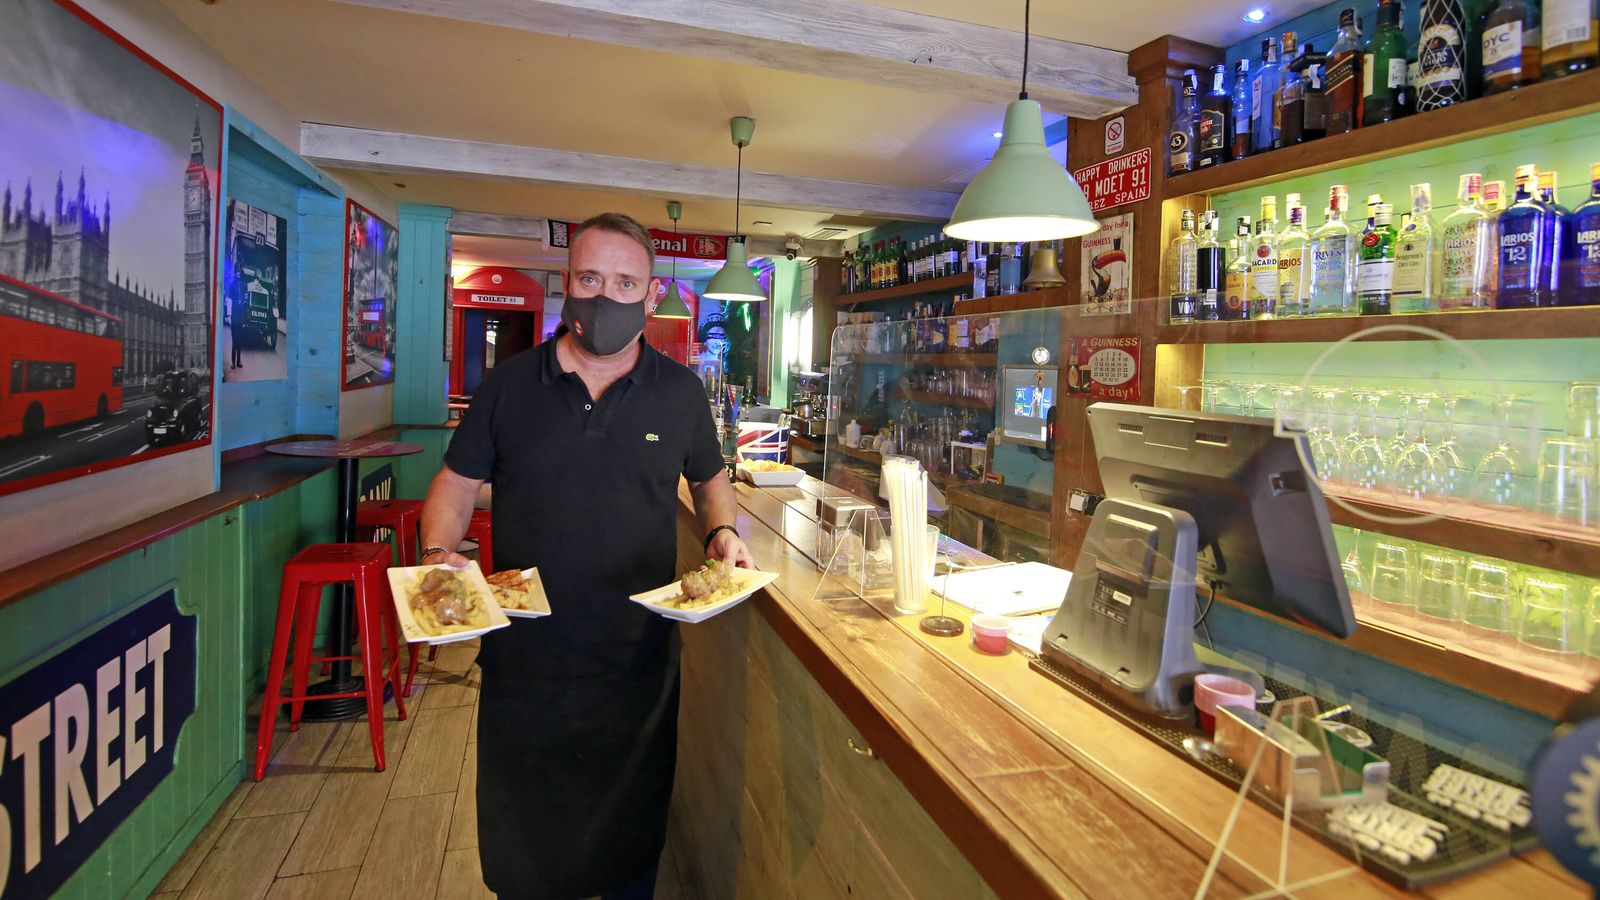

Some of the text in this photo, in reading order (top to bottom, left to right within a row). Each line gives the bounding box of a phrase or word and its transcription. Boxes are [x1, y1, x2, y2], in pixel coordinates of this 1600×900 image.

[1171, 136, 1182, 147] 43
[1076, 150, 1149, 184] HAPPY DRINKERS
[1095, 173, 1125, 198] MOET
[1131, 166, 1146, 187] 91
[1089, 186, 1147, 210] REZ SPAIN
[1102, 224, 1113, 232] day
[1082, 236, 1112, 249] GUINNESS
[1501, 232, 1537, 247] LARIOS
[1577, 230, 1600, 244] LARI
[651, 237, 687, 252] enal
[1505, 246, 1527, 262] 12
[1252, 258, 1277, 267] BACARD
[477, 295, 508, 303] TOILET
[1178, 302, 1195, 314] VOX
[1081, 337, 1138, 348] A GUINNESS
[1109, 387, 1133, 400] day!
